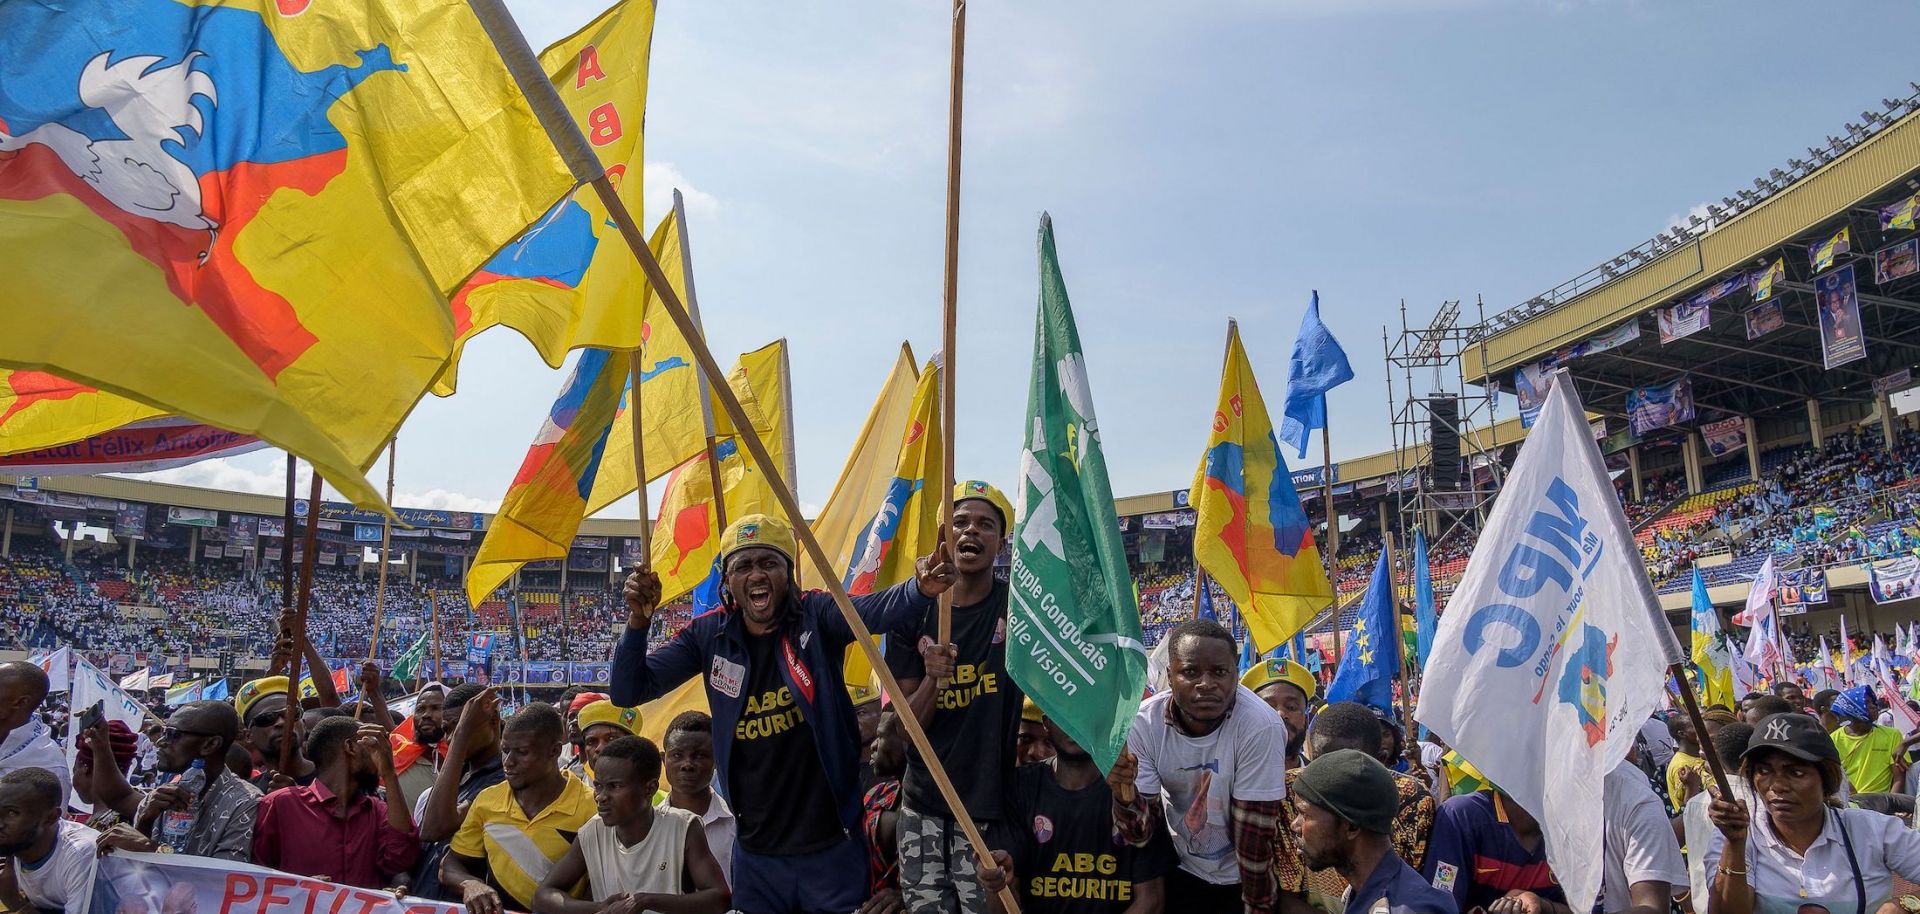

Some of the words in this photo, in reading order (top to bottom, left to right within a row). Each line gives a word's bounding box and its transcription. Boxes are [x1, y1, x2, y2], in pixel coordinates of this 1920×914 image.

[86, 435, 144, 456] Félix
[150, 432, 239, 451] Antoine
[1030, 640, 1078, 696] Vision
[745, 686, 793, 716] ABG
[735, 707, 804, 740] ECURIT
[1051, 853, 1117, 875] ABG
[1030, 876, 1132, 901] SECURITE
